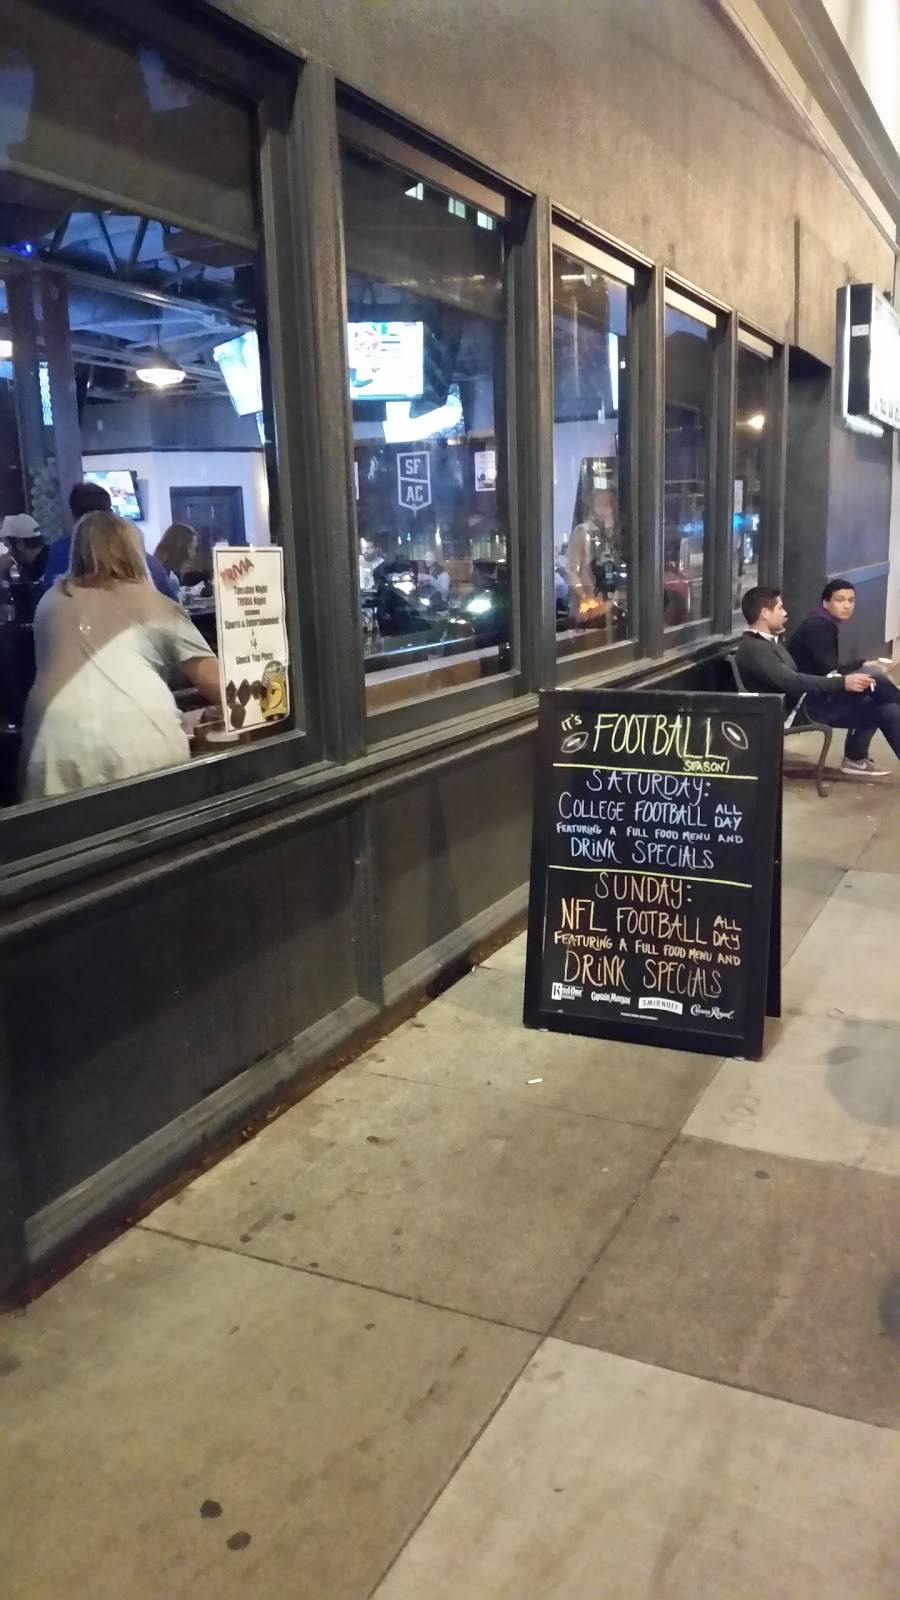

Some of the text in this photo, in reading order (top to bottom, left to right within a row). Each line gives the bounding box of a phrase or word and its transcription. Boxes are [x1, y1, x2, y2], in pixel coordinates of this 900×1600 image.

[405, 459, 421, 474] SF
[406, 486, 423, 502] AC
[593, 713, 729, 760] FOOTBALL
[682, 759, 731, 773] SEASON!
[586, 769, 712, 806] SATURDAY:
[558, 791, 743, 827] COLLEGE FOOTBALL ALL
[714, 816, 742, 831] DAY
[609, 826, 617, 836] A
[626, 826, 649, 839] FULL
[655, 828, 679, 840] FOOD
[683, 830, 711, 843] MENU
[717, 833, 744, 844] AND
[595, 872, 692, 910] SUNDAY:
[561, 897, 742, 945] NFL FOOTBALL ALL
[712, 930, 741, 950] DAY
[619, 937, 628, 951] A
[635, 939, 659, 955] FULL
[663, 944, 686, 959] FOOD
[688, 948, 712, 964] MENU
[717, 953, 741, 967] AND
[642, 999, 679, 1011] SMIRNOFF
